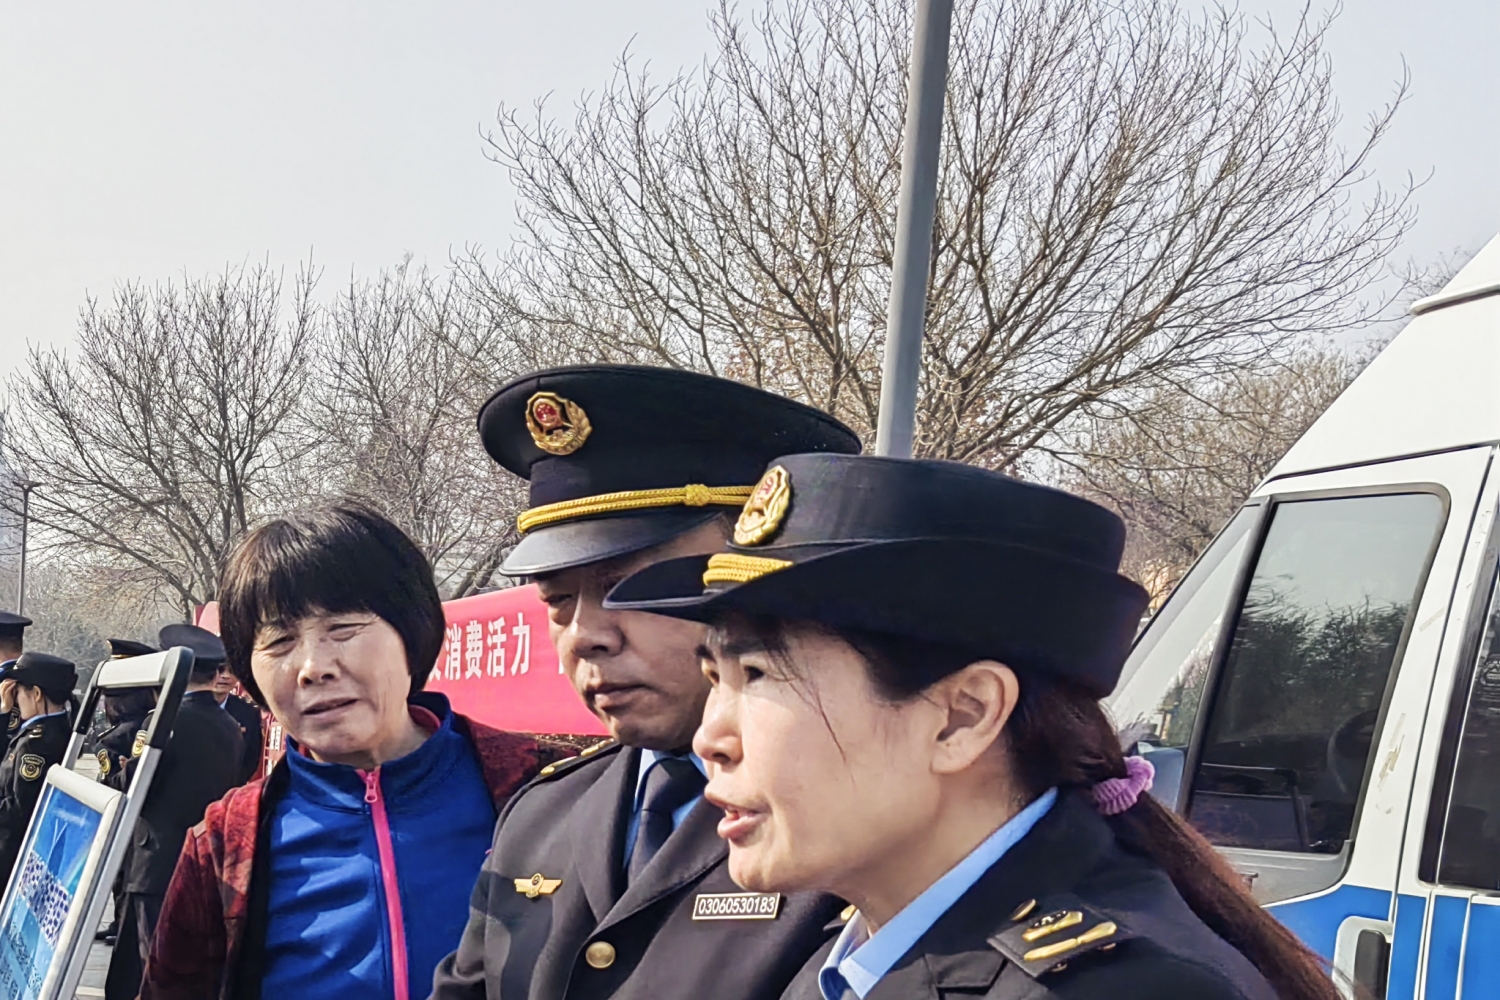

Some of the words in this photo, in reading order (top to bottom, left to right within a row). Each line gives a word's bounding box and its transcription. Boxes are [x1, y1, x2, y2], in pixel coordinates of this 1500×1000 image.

[429, 612, 531, 682] 消费活力
[698, 896, 776, 915] 03060530183
